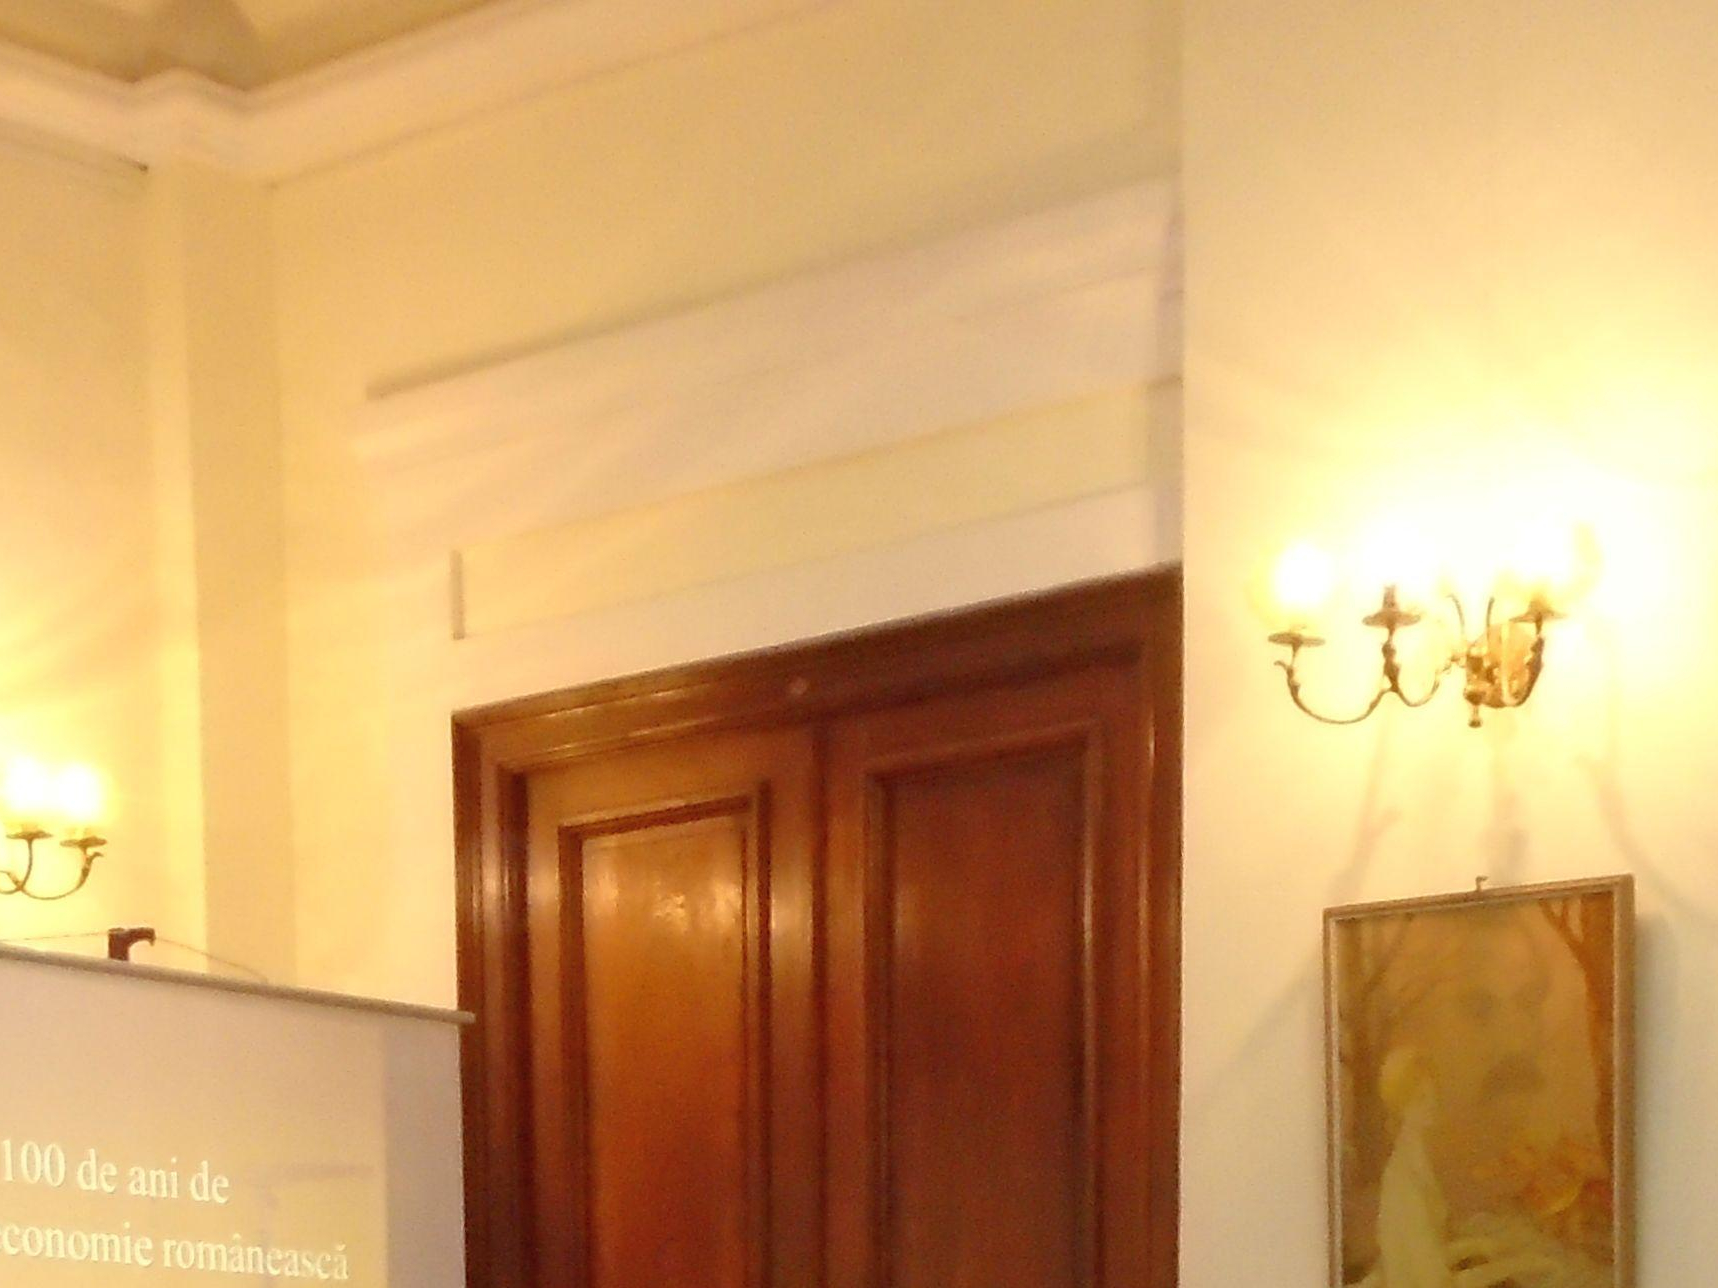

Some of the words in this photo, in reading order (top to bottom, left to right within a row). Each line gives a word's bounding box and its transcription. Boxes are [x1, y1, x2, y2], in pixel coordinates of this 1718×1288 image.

[0, 1138, 66, 1188] 100
[76, 1148, 118, 1192] de
[129, 1156, 179, 1198] ani
[189, 1160, 230, 1205] de
[163, 1233, 350, 1281] românească
